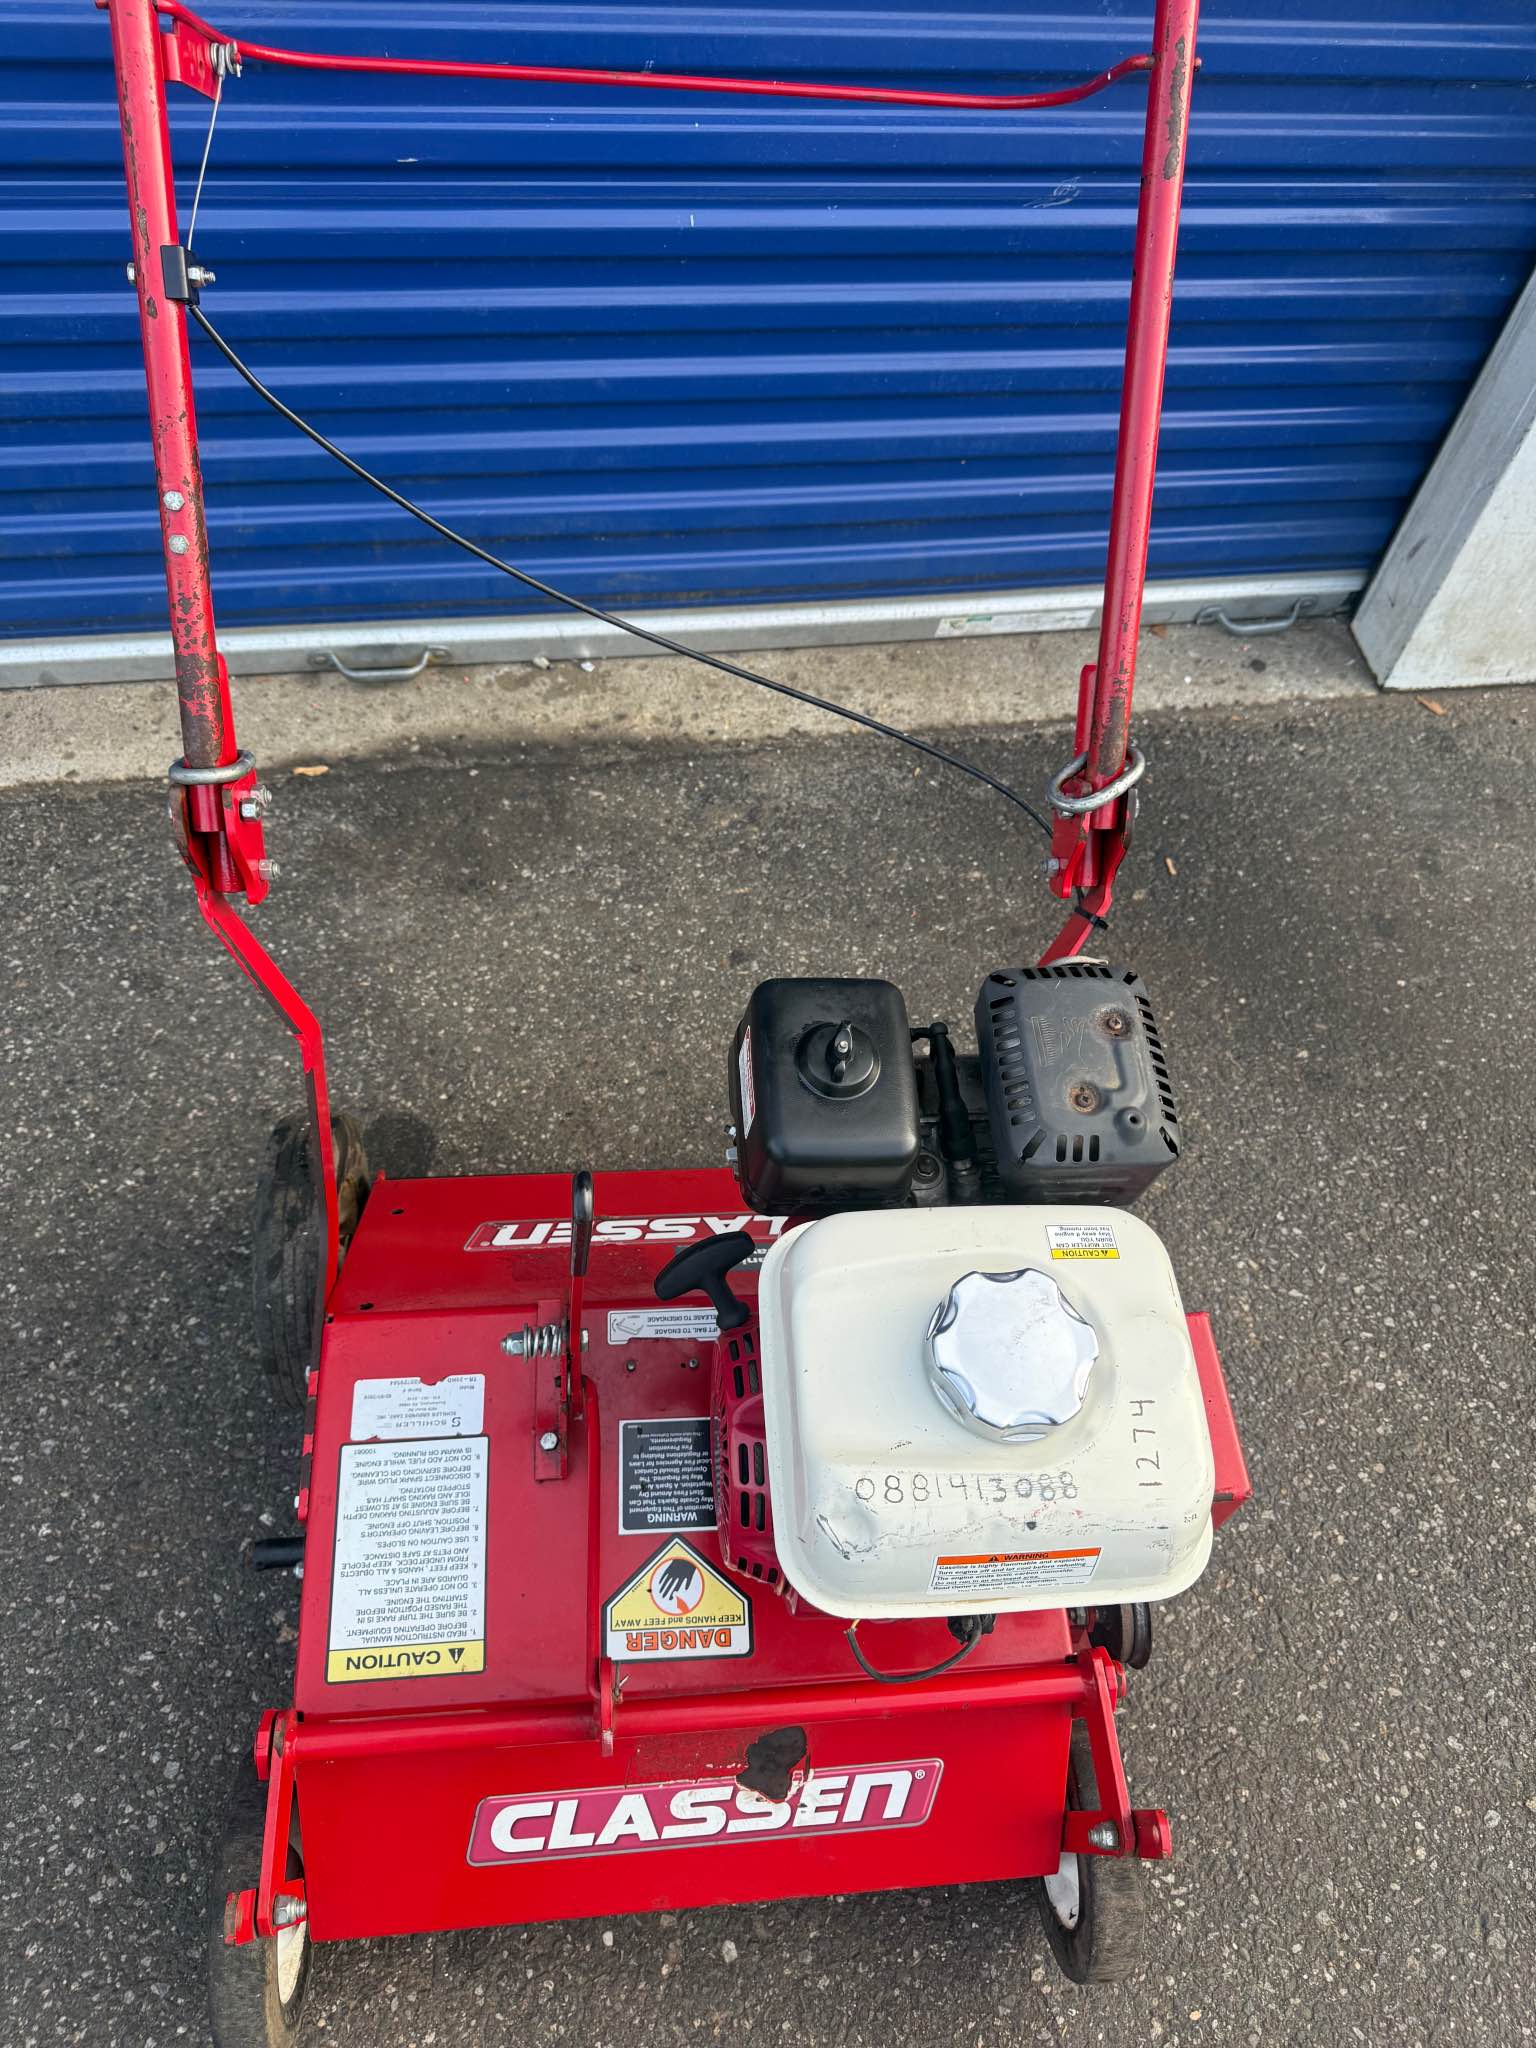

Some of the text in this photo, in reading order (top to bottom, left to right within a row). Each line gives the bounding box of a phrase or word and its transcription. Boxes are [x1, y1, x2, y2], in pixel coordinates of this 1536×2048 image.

[402, 1466, 440, 1474] SERVICING
[442, 1464, 470, 1472] BEFORE
[424, 1472, 470, 1481] DISCONNECT
[437, 1483, 470, 1491] STOPPED
[355, 1503, 389, 1511] SLOWEST
[629, 1506, 660, 1514] Equipment
[684, 1503, 713, 1511] Operation
[369, 1510, 396, 1518] RAKING
[398, 1508, 439, 1516] ADJUSTING
[646, 1511, 696, 1522] WARNING
[408, 1526, 438, 1534] LEAVING
[440, 1524, 469, 1532] BEFORE
[362, 1551, 398, 1560] DISTANCE.
[1002, 1552, 1049, 1560] WARNING
[341, 1561, 370, 1569] PEOPLE
[398, 1565, 423, 1573] HANDS
[340, 1568, 374, 1577] OBJECTS
[437, 1574, 468, 1582] GUARDS
[373, 1586, 402, 1594] UNLESS
[405, 1584, 437, 1592] OPERATE
[384, 1597, 413, 1605] ENGINE.
[432, 1593, 467, 1601] STARTING
[355, 1607, 385, 1615] BEFORE
[387, 1604, 422, 1613] POSITION
[614, 1614, 740, 1627] KEEP HANDS and FEET AWAY
[346, 1621, 466, 1635] BEFORE OPERATING EQUIPMENT.
[395, 1631, 444, 1640] INSTRUCTION
[446, 1629, 466, 1637] READ
[361, 1634, 391, 1643] MANUAL
[626, 1628, 731, 1651] DANGER
[346, 1650, 440, 1670] CAUTION
[490, 1770, 915, 1854] CLASSEN
